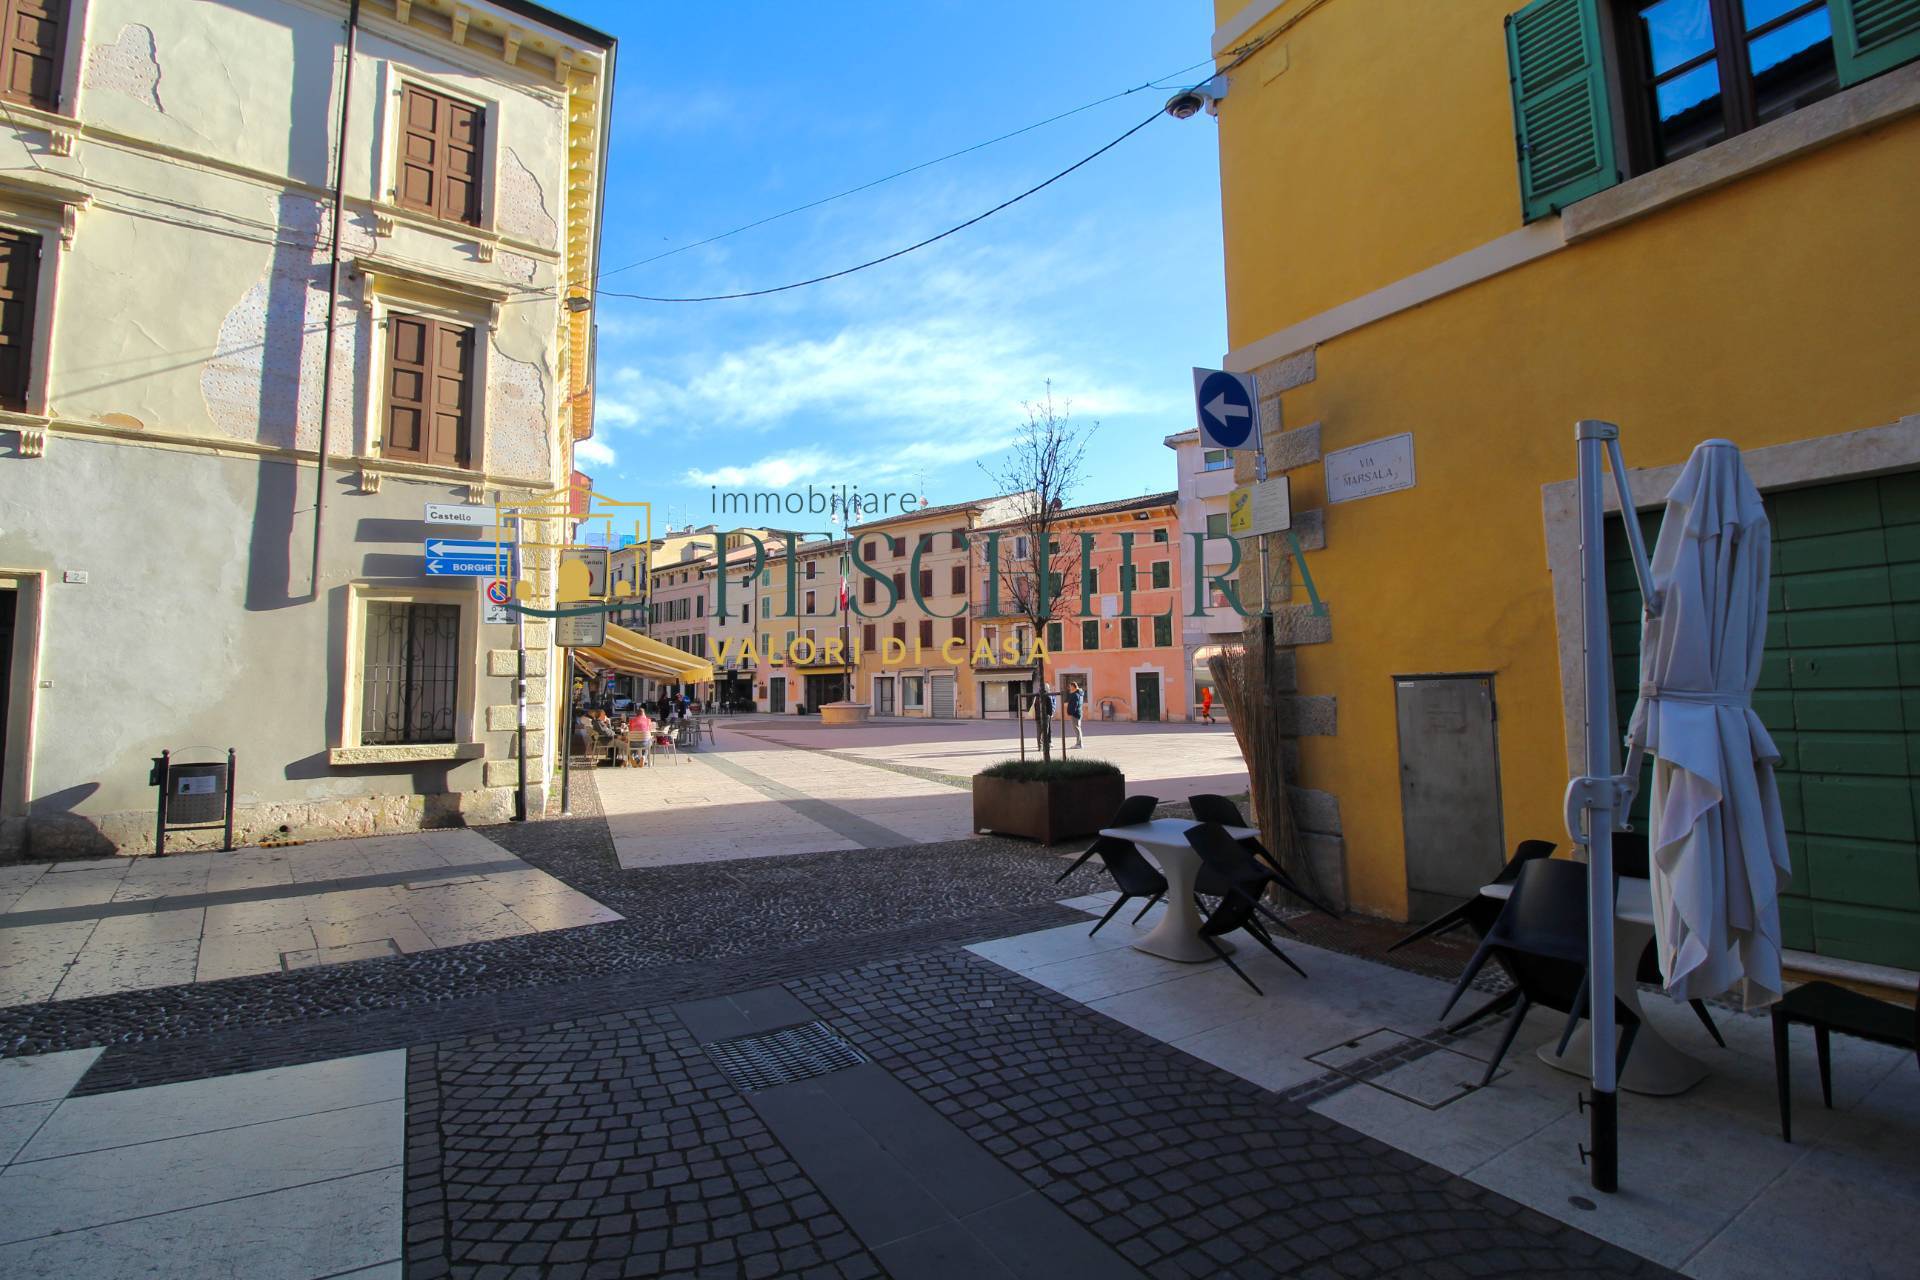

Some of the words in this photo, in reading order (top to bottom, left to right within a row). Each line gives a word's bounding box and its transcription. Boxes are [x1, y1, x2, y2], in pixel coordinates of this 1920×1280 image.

[1359, 457, 1375, 468] VIA
[1343, 468, 1394, 487] MARSALA
[430, 511, 472, 521] Castello
